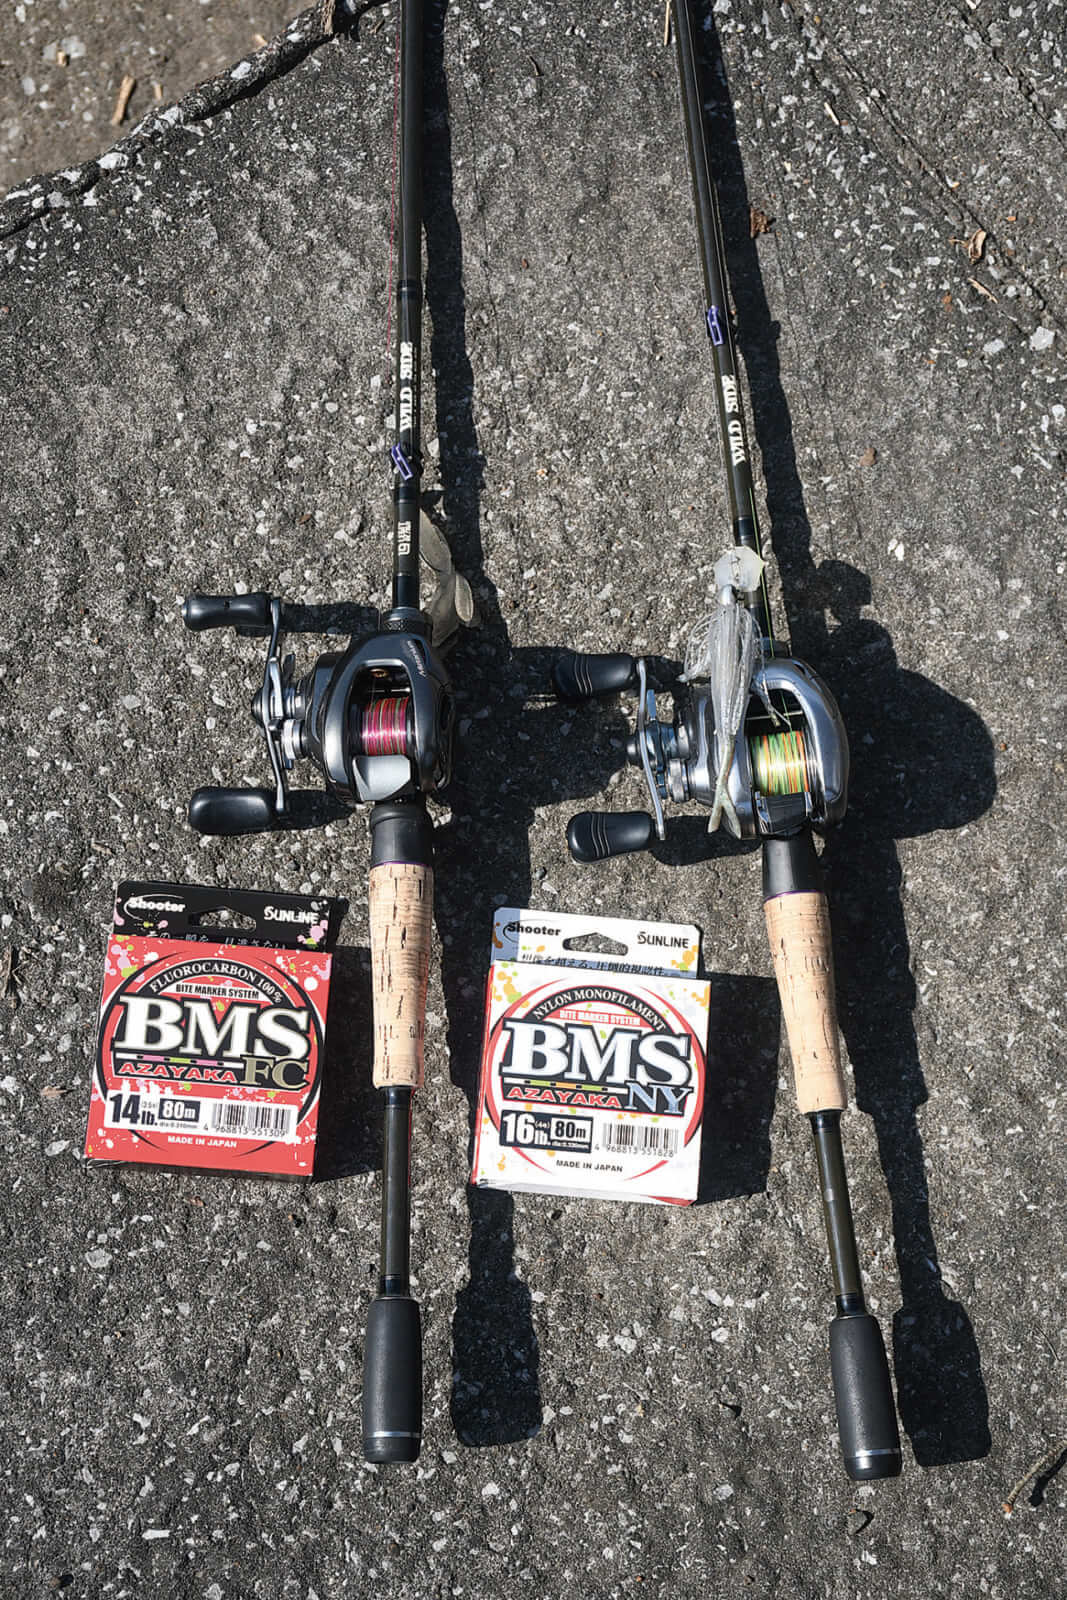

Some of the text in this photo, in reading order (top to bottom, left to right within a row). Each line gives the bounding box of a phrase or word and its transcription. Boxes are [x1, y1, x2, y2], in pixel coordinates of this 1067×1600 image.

[399, 341, 413, 433] WILD SIDE
[721, 374, 746, 466] WILD SIDE
[128, 897, 186, 913] Shooter
[263, 906, 320, 924] SUNLINE
[507, 922, 562, 936] Shooter
[637, 931, 690, 949] SUNLINE
[150, 962, 256, 994] FLUOROCARBON
[175, 984, 259, 999] BITE MARKER SYSTEM
[533, 988, 665, 1032] NYLON MONOFILAMENT
[610, 1013, 641, 1026] SYSTEM
[114, 995, 311, 1059] BMS
[502, 1021, 692, 1087] BMS
[118, 1063, 238, 1084] AZAYAKA
[240, 1056, 309, 1090] FC
[508, 1087, 621, 1108] AZAYAKA
[625, 1082, 694, 1114] NY
[162, 1101, 197, 1120] 80m
[555, 1121, 587, 1139] 80m
[167, 1135, 237, 1148] MADE IN JAPAN
[556, 1160, 623, 1173] MADE IN JAPAN
